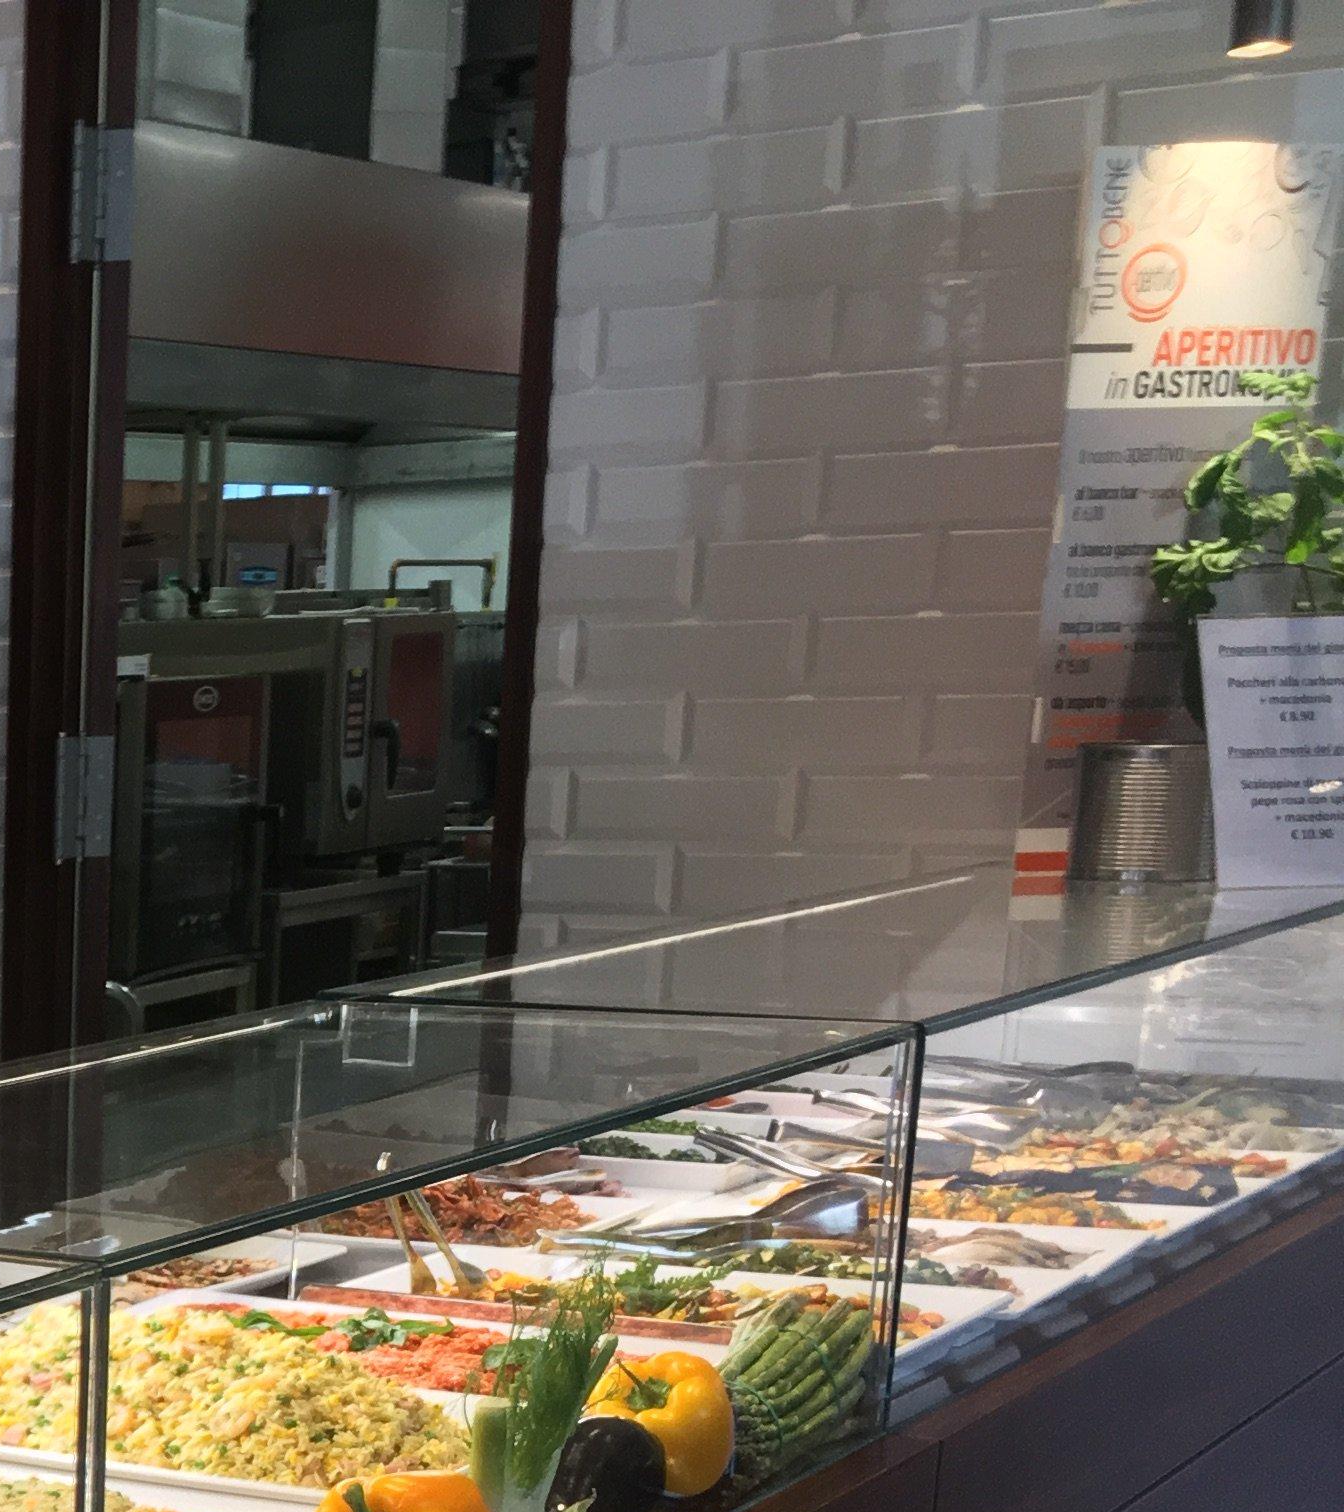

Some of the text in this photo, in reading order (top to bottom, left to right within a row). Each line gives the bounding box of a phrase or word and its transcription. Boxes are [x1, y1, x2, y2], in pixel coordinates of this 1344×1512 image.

[1089, 158, 1136, 315] TUTTOBENE
[1152, 328, 1316, 367] APERITIVO
[1105, 369, 1312, 400] in GASTRON
